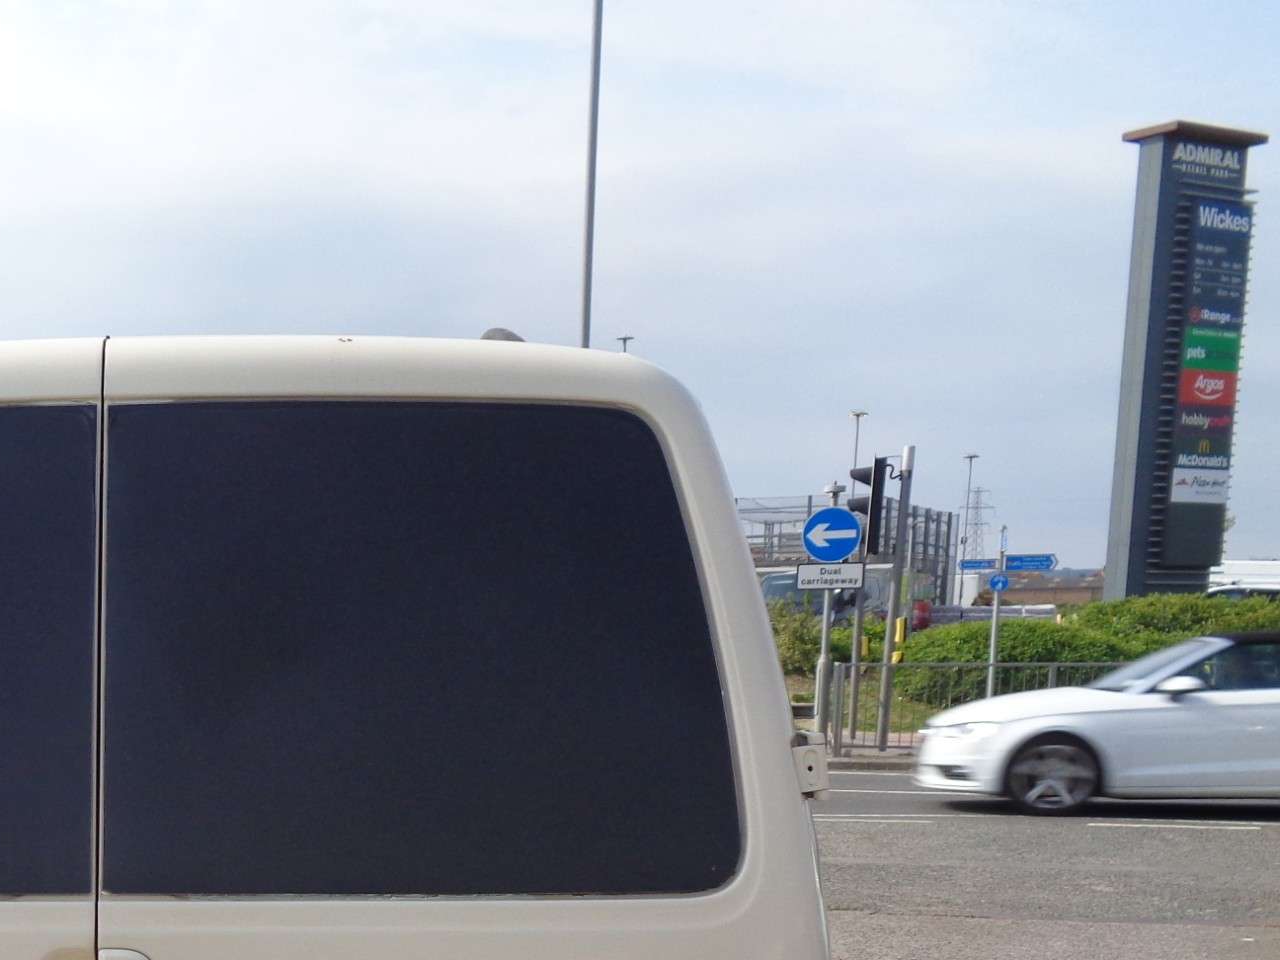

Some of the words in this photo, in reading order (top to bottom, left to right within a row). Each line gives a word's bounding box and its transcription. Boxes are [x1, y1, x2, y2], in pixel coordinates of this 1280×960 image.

[1172, 142, 1240, 169] ADMIRAL
[1199, 205, 1250, 233] Wickes
[1195, 373, 1225, 394] Argos
[800, 577, 859, 586] carriageway
[820, 567, 842, 575] Dual
